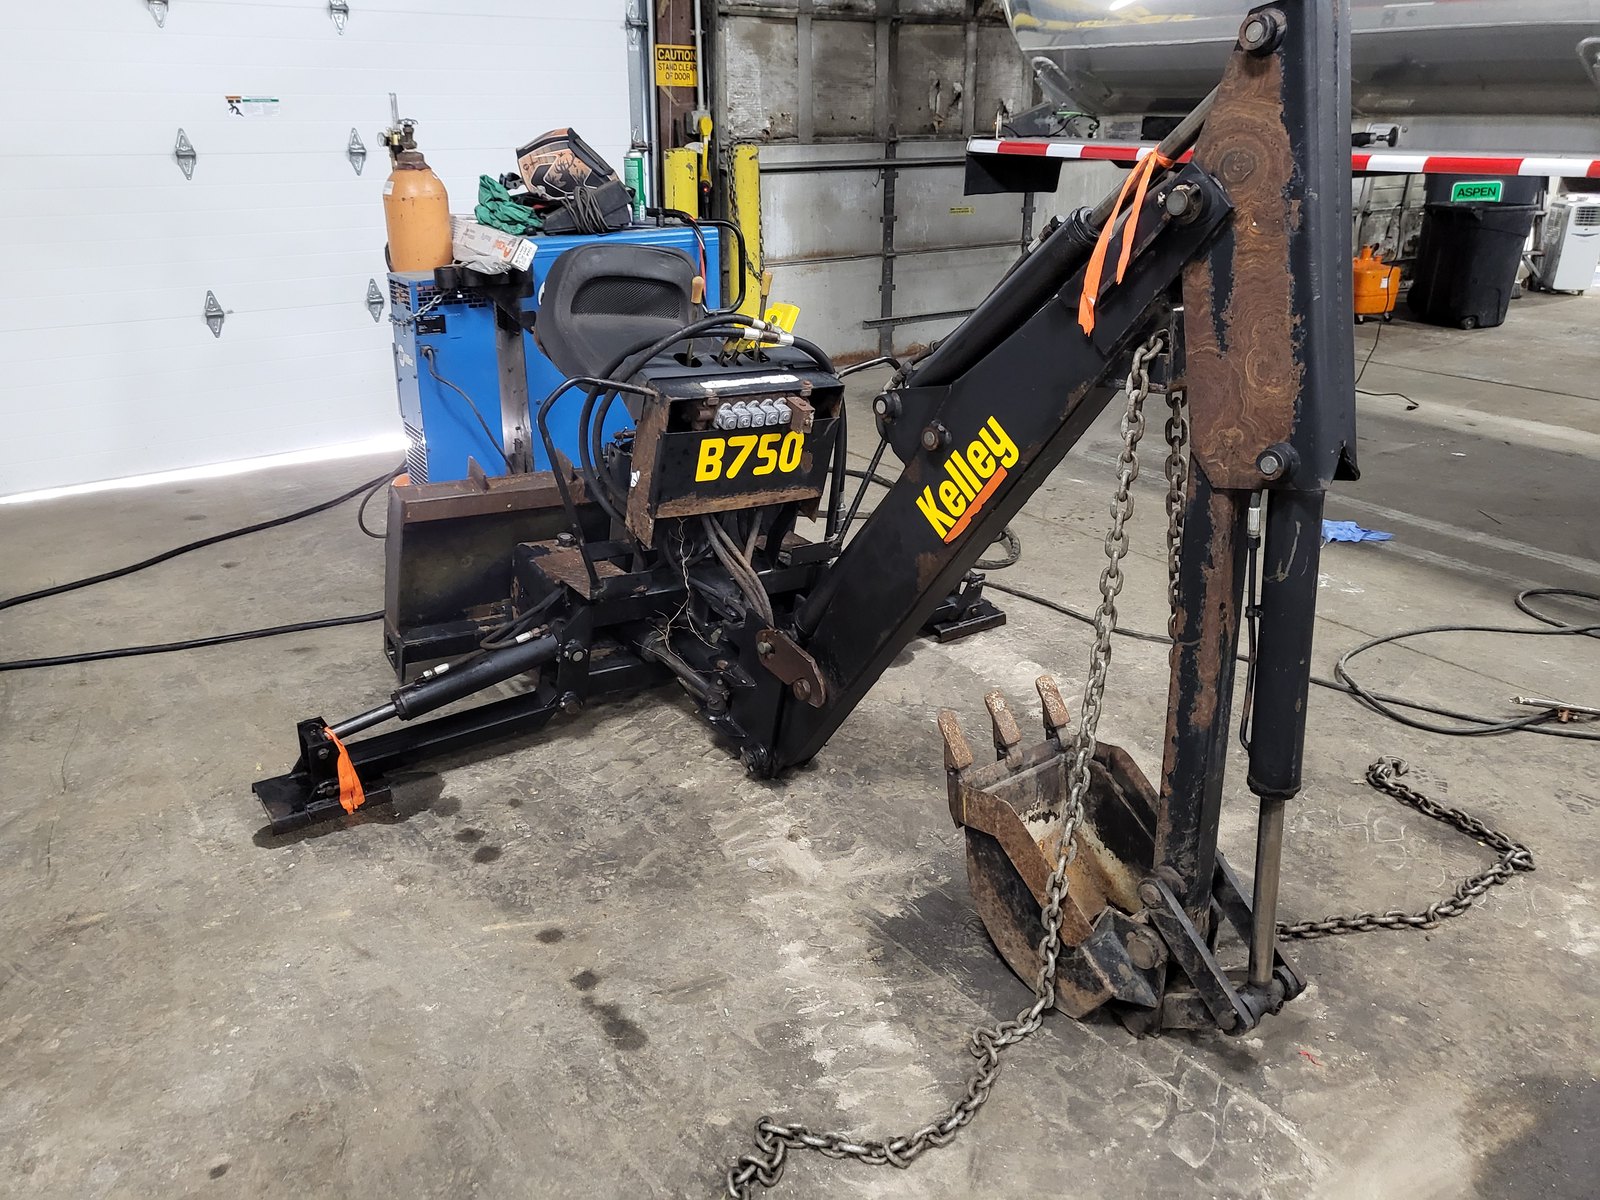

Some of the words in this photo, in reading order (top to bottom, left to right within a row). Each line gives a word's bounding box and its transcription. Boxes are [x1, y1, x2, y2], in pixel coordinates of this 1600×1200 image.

[658, 49, 697, 61] CAUTION
[658, 62, 677, 71] STAND
[674, 72, 691, 81] DOOR
[1457, 187, 1496, 197] ASPEN
[695, 430, 805, 482] B750
[915, 415, 1020, 540] Kelley
